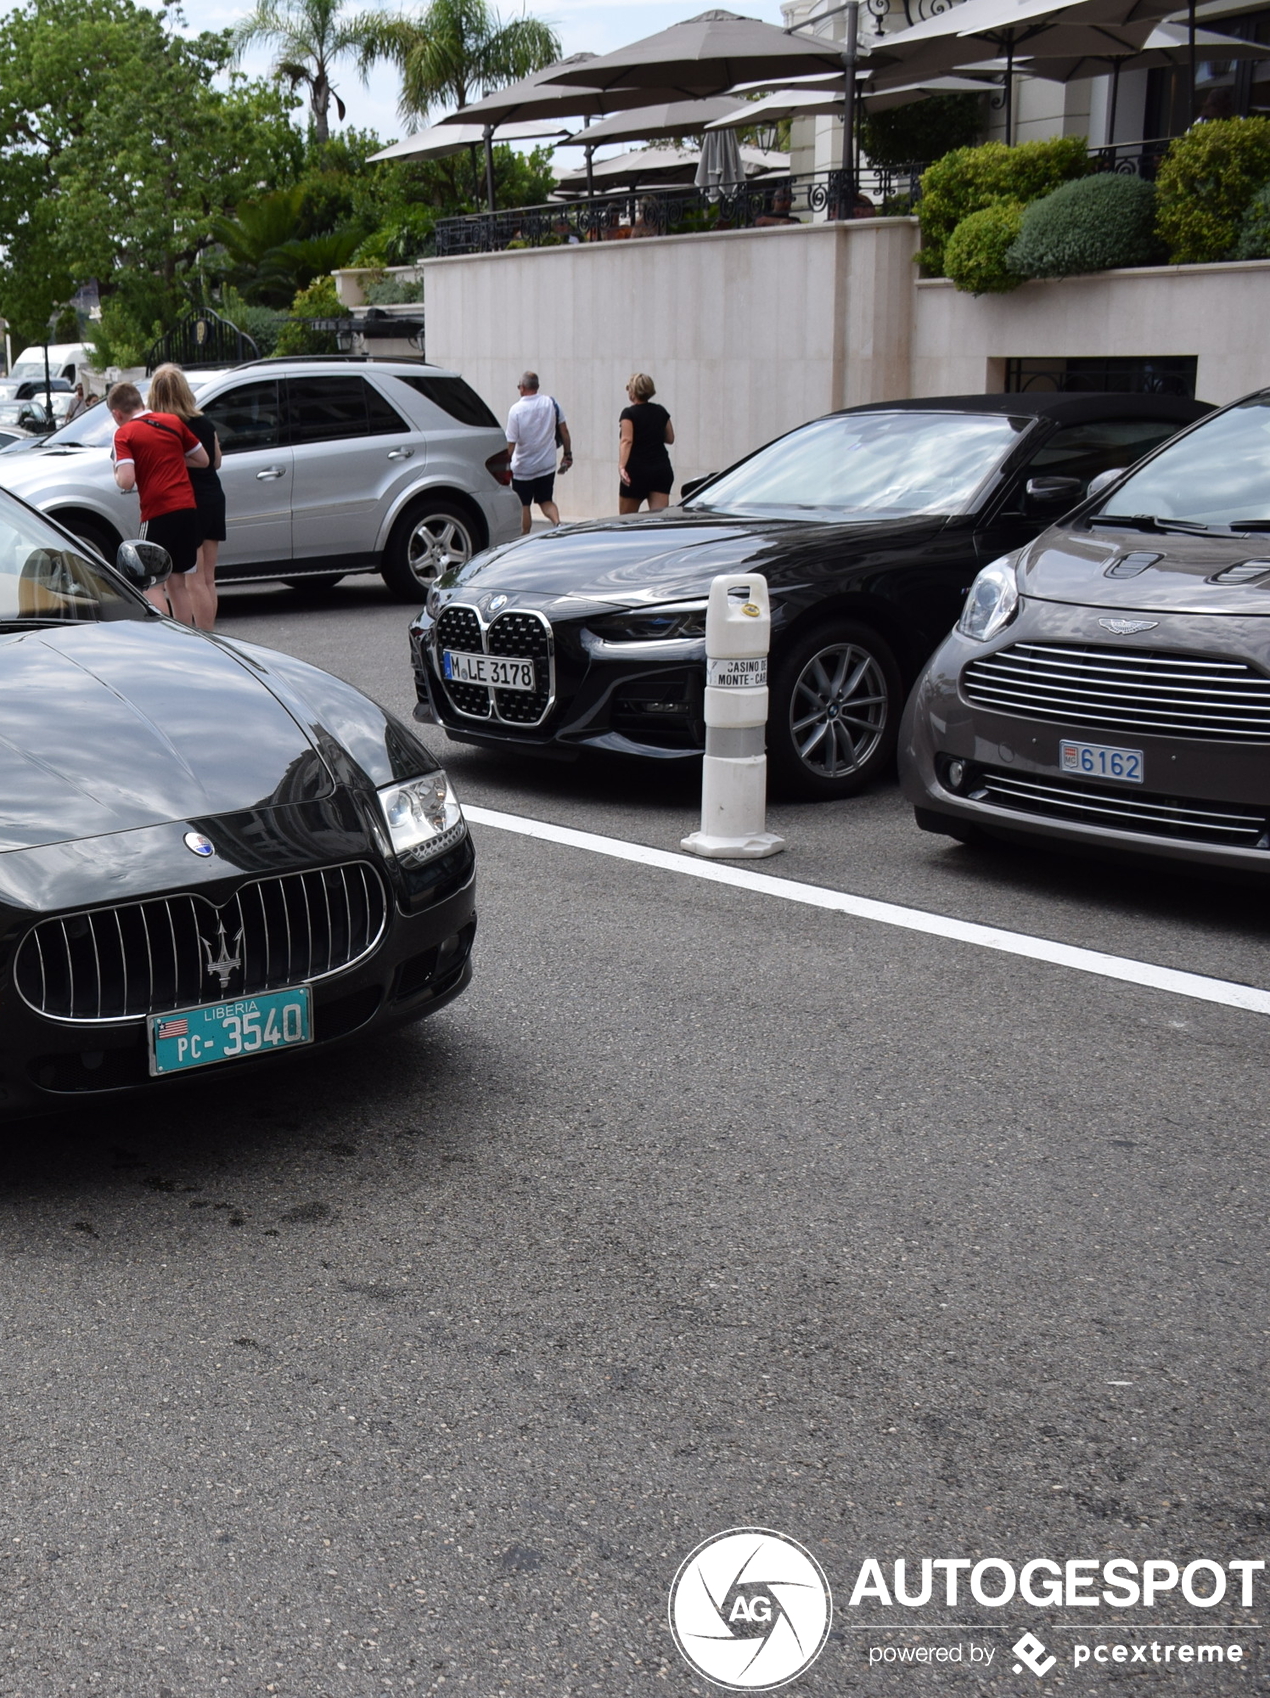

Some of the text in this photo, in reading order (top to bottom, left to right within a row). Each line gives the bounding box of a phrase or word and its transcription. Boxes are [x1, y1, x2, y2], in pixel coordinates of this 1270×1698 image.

[451, 655, 532, 686] M LE 3178
[727, 661, 759, 673] CASINO
[1081, 748, 1139, 779] 6162
[204, 1000, 258, 1022] LIBERIA
